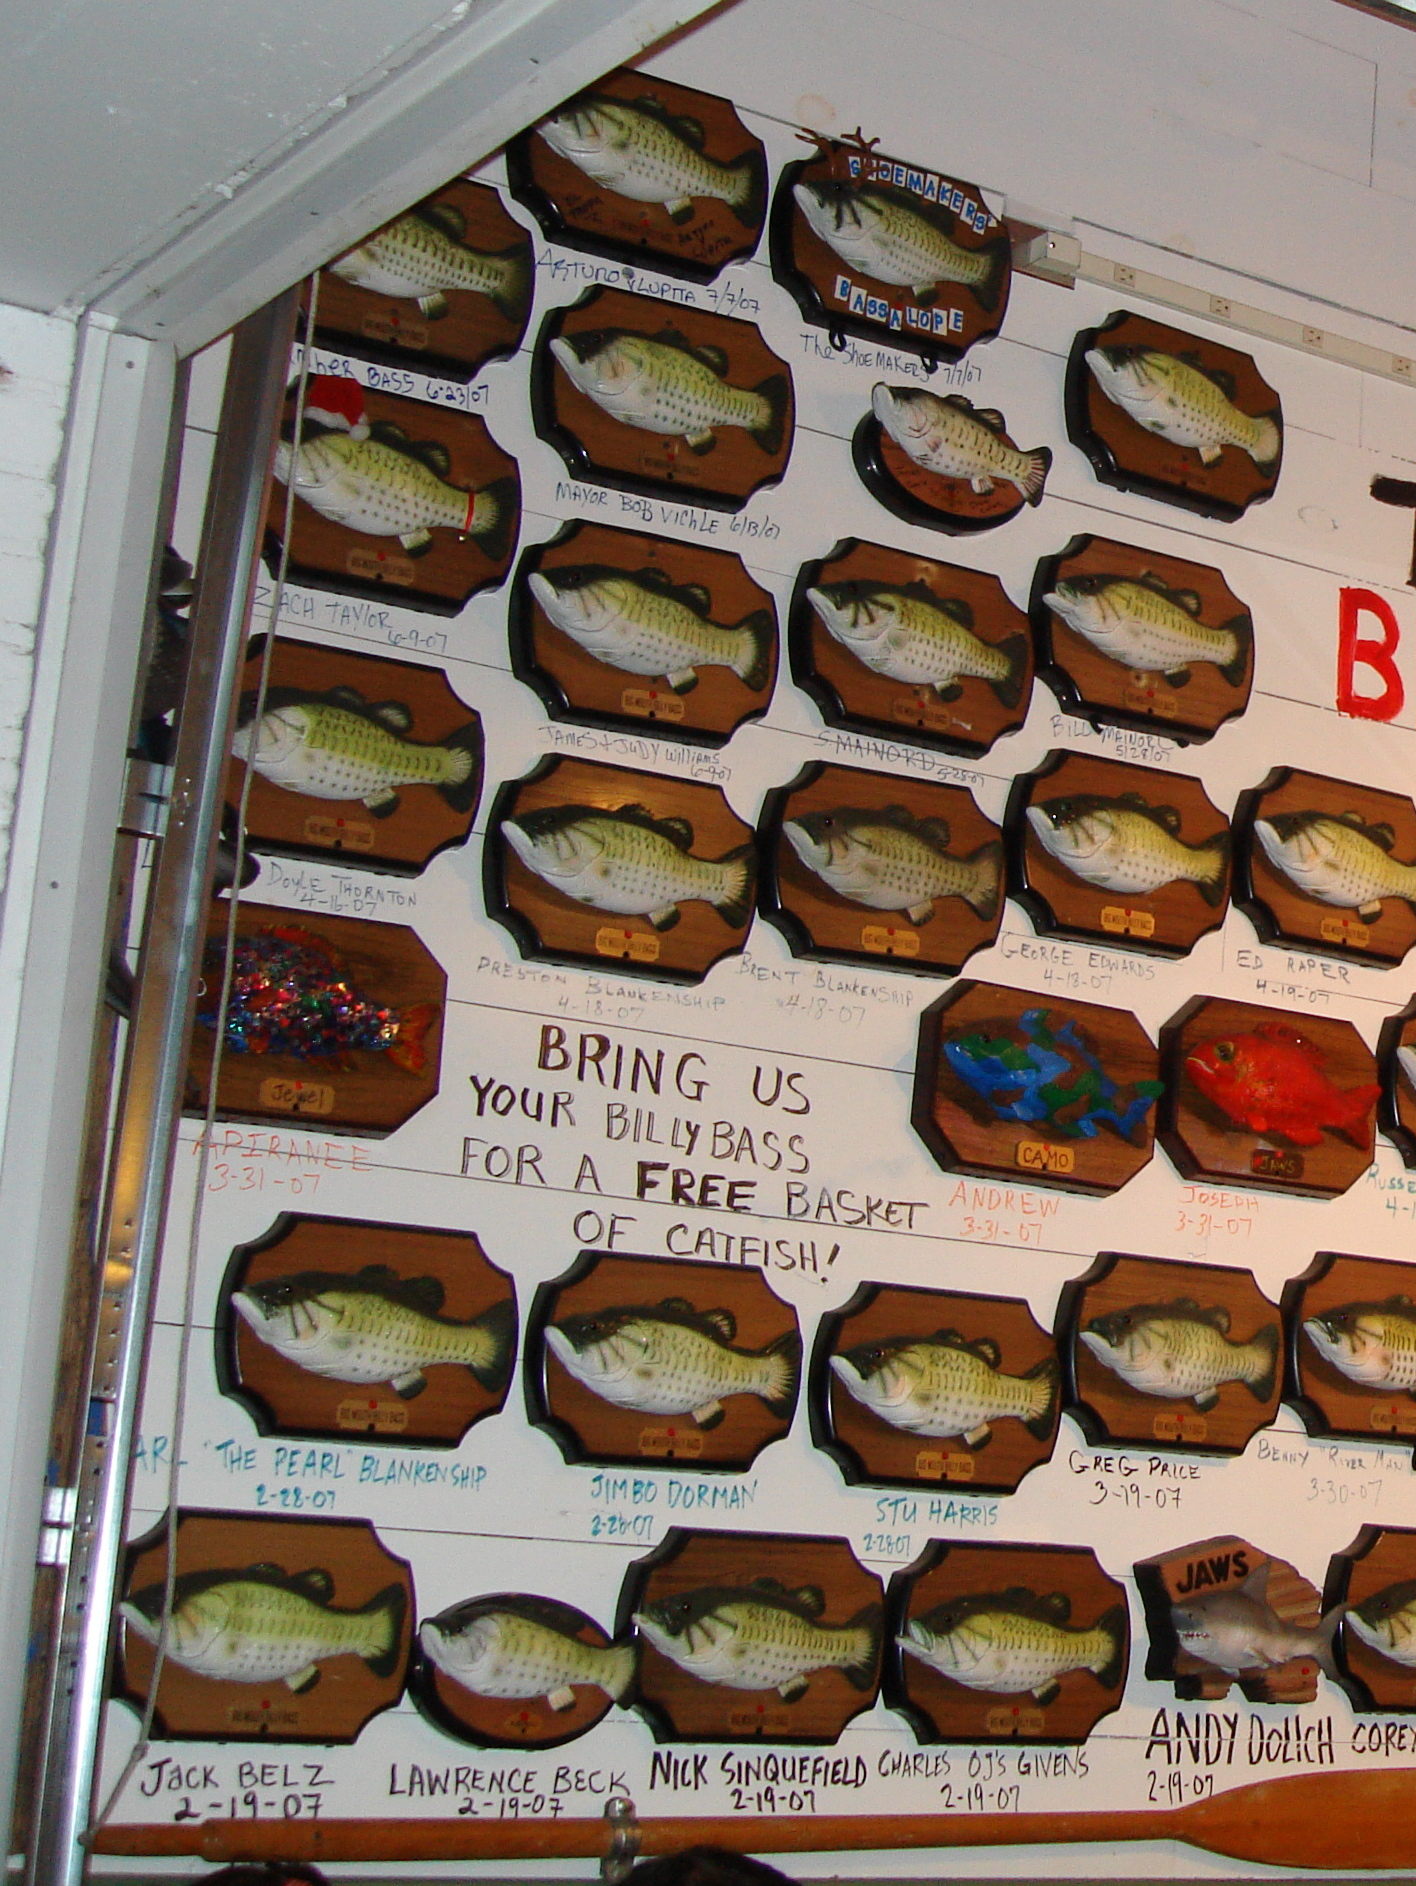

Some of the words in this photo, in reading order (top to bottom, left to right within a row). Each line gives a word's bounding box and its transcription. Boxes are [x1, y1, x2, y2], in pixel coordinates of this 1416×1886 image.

[838, 276, 964, 334] BASSALOPE
[367, 366, 414, 393] BASS
[556, 482, 608, 506] MAYOR
[619, 494, 653, 521] BOB
[539, 726, 597, 749] JAMES
[836, 734, 935, 771] MAINORD
[267, 862, 325, 893] DOYLE
[331, 874, 417, 907] THORNTON
[1000, 929, 1076, 969] GEORGE
[1087, 950, 1156, 981] EDWARDS
[1236, 949, 1264, 971] ED
[1287, 958, 1351, 984] RAPER
[477, 955, 568, 986] PRESTON
[585, 975, 728, 1012] BLANKENSHIP
[735, 952, 801, 988] BRENT
[813, 969, 916, 1008] BLANKENSHIP
[1043, 968, 1113, 991] 4-18-07
[537, 1024, 710, 1101] BRING
[752, 1065, 812, 1115] US
[469, 1075, 577, 1128] YOUR
[1021, 1144, 1070, 1170] CAMO
[208, 1163, 321, 1194] 3-31-07
[461, 1137, 546, 1186] FOR
[574, 1154, 603, 1194] A
[635, 1160, 758, 1213] FREE
[786, 1181, 931, 1230] BASKET
[948, 1180, 1062, 1217] ANDREW
[1181, 1184, 1262, 1213] JOSEPH
[960, 1216, 1044, 1245] 3-31-07
[1176, 1210, 1253, 1237] 3-31-07
[573, 1211, 637, 1250] OF
[666, 1223, 842, 1284] CATFISH!
[358, 1454, 487, 1492] BLANKENSHIP
[1069, 1450, 1138, 1477] GREG
[1147, 1457, 1202, 1480] PRICE
[590, 1474, 658, 1505] JIMBO
[666, 1478, 758, 1510] DORMAN
[1089, 1481, 1182, 1508] 3-19-07
[875, 1497, 918, 1526] STU
[928, 1501, 999, 1526] HARRIS
[1176, 1550, 1249, 1595] JAWS
[1144, 1708, 1240, 1766] ANDY
[238, 1762, 335, 1789] BELZ
[389, 1763, 536, 1796] LAWRENCE
[554, 1767, 632, 1797] BECK
[649, 1751, 709, 1791] NICK
[720, 1752, 867, 1789] SINQUEFIELD
[878, 1750, 952, 1780] CHARLES
[1017, 1745, 1090, 1780] GIVENS
[732, 1788, 816, 1813] 2-19-07
[940, 1784, 1020, 1812] 2-19-07
[1146, 1771, 1214, 1803] 2-19-07
[175, 1793, 323, 1819] 2-19-07
[457, 1795, 564, 1817] 2-19-07
